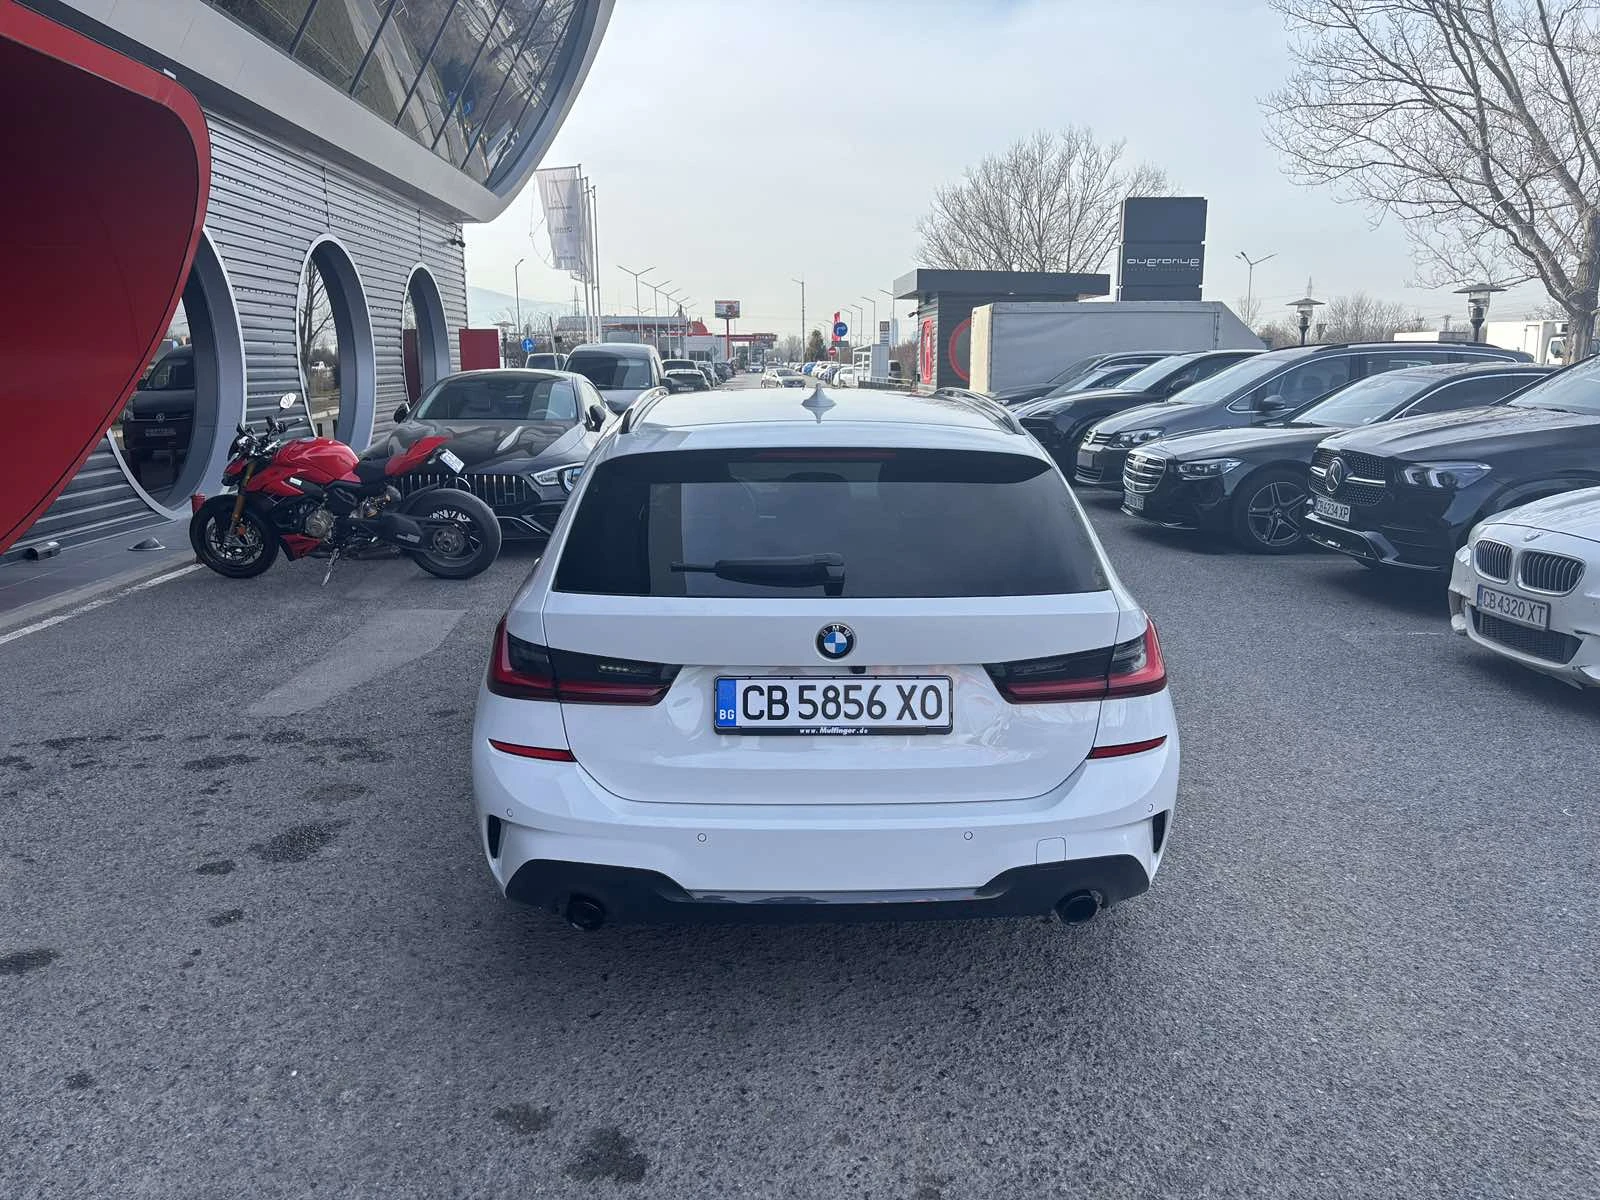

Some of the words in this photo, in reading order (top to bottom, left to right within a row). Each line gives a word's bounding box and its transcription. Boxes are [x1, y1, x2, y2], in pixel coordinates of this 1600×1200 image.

[1483, 590, 1496, 609] CB
[1498, 595, 1525, 618] 4320
[1527, 604, 1545, 623] XT
[822, 625, 852, 637] BMW
[742, 685, 790, 721] CB
[798, 684, 887, 720] 5856
[896, 684, 943, 721] XO
[719, 709, 735, 720] BG
